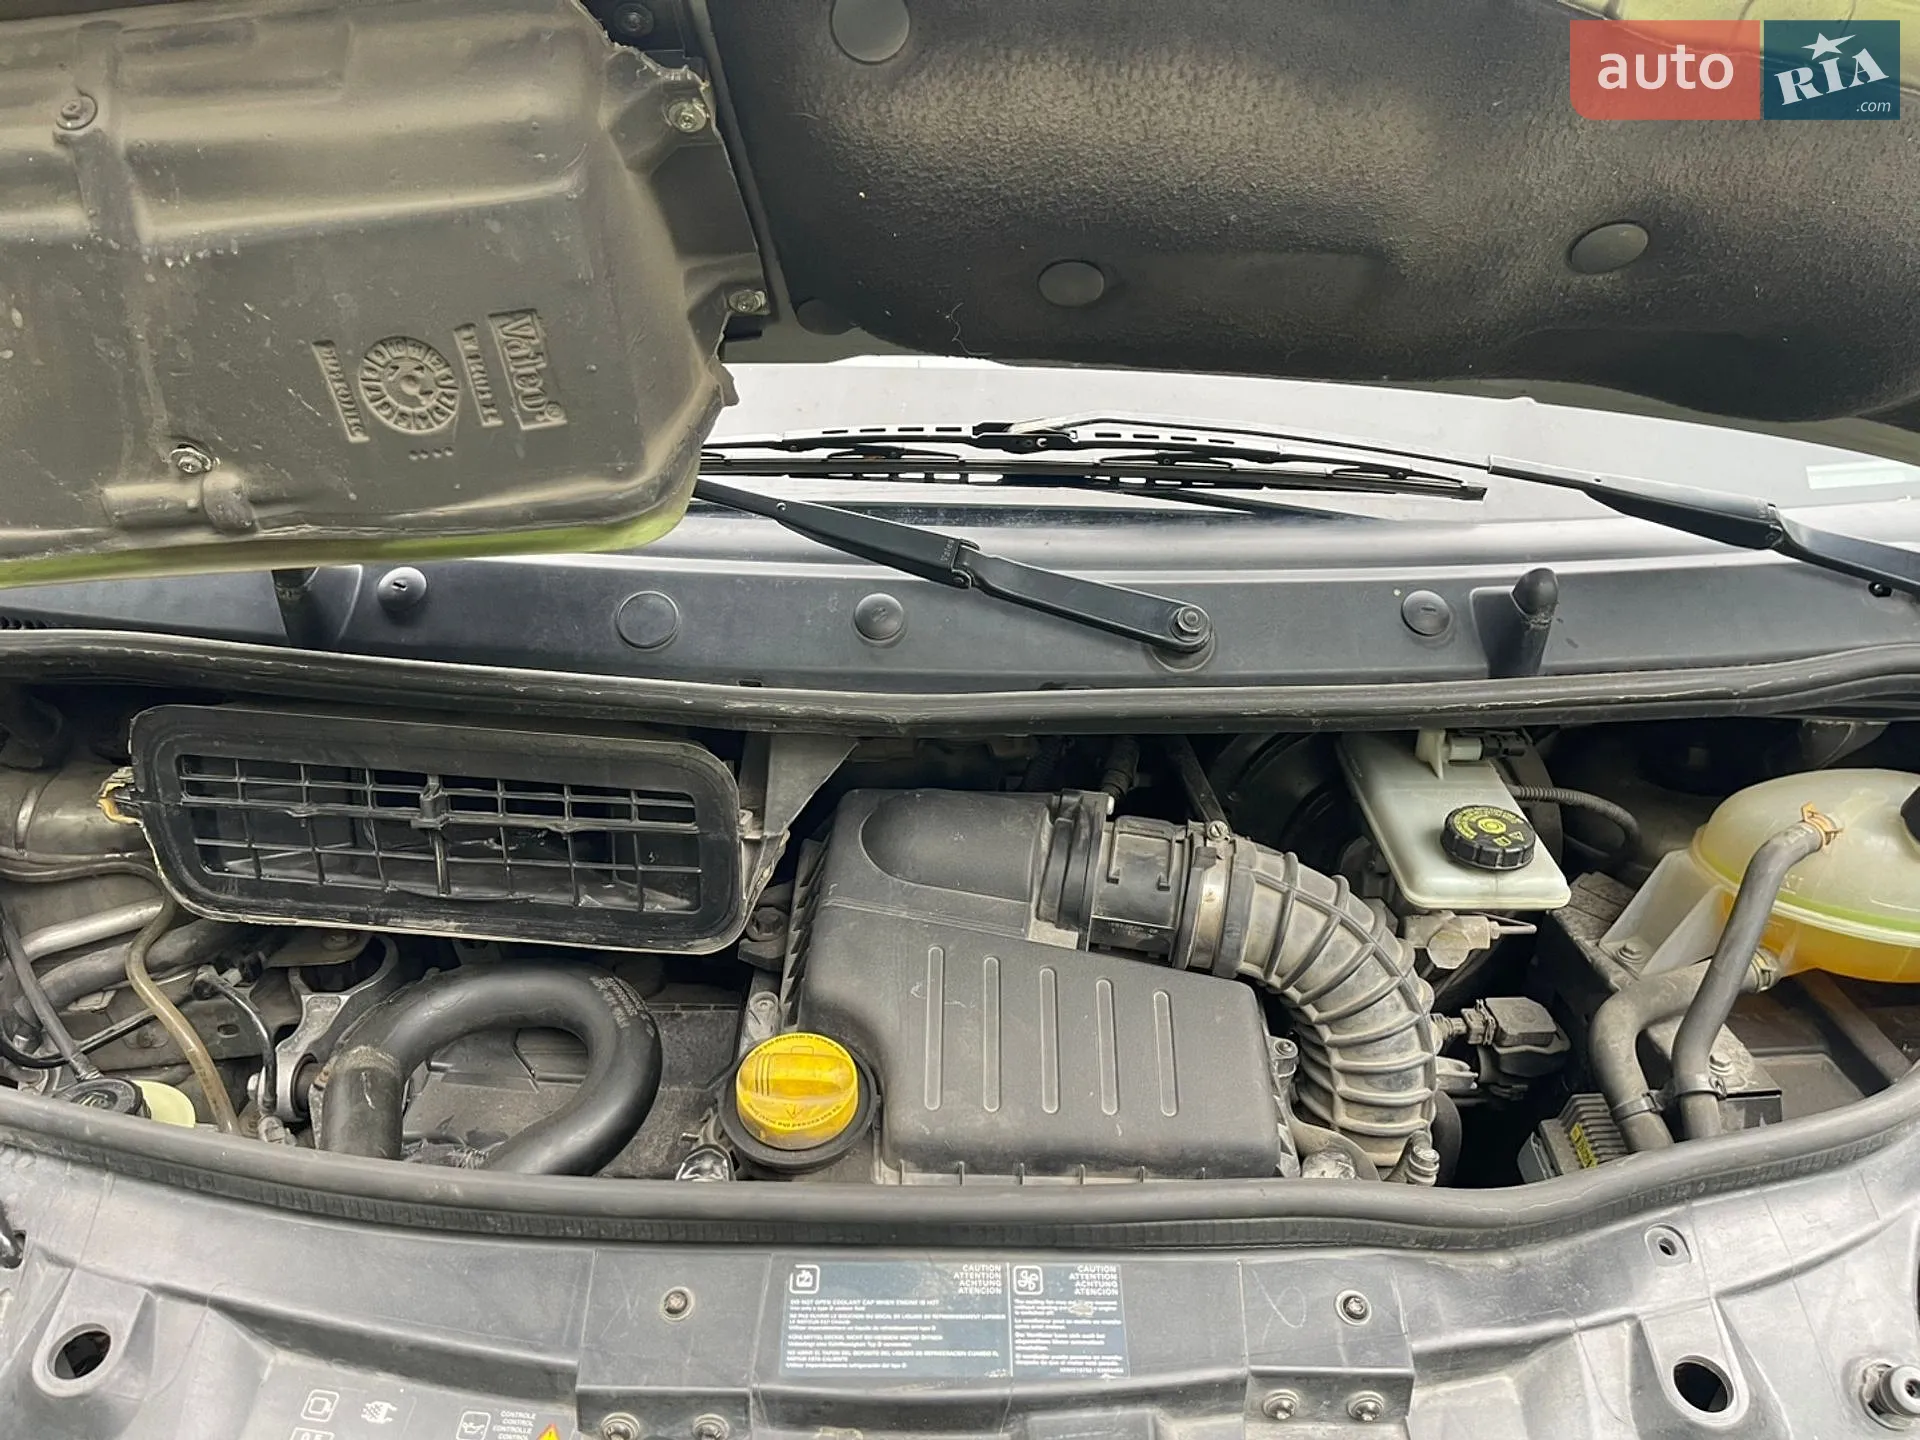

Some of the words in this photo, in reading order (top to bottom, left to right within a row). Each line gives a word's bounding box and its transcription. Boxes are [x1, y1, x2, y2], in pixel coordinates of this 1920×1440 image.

[962, 1264, 1001, 1272] CAUTION
[1077, 1265, 1117, 1273] CAUTION
[953, 1271, 1001, 1279] ATTENTION
[959, 1279, 1002, 1287] ACHTUNG
[1075, 1280, 1118, 1288] ACHTUNG
